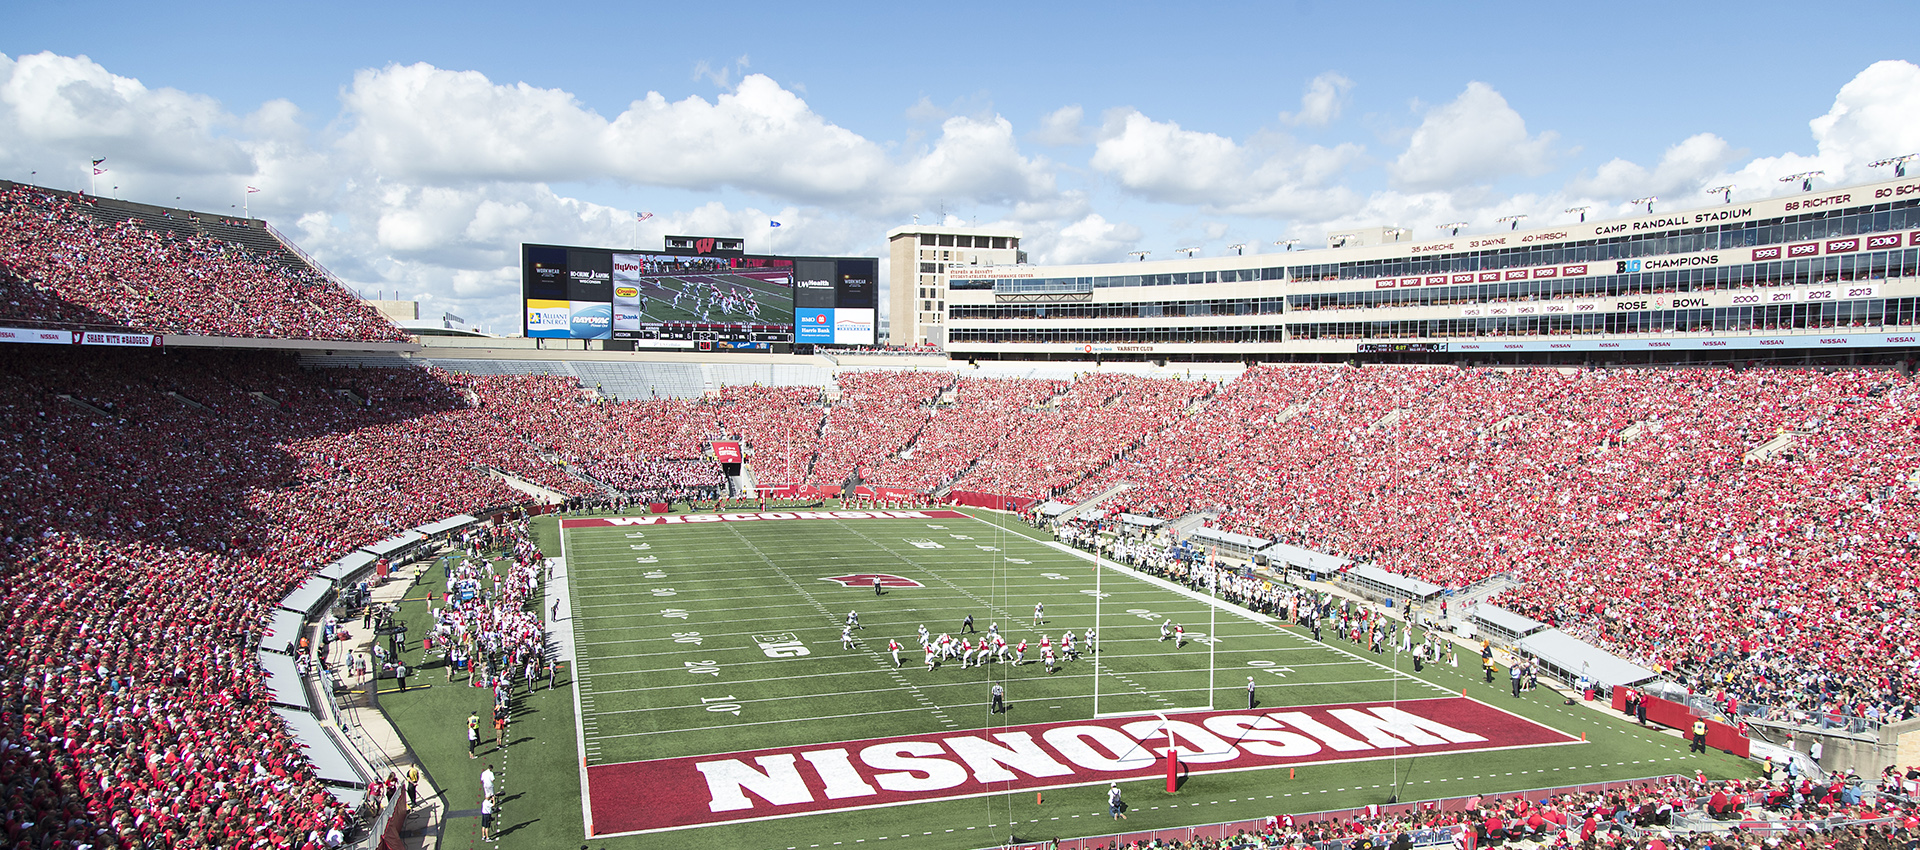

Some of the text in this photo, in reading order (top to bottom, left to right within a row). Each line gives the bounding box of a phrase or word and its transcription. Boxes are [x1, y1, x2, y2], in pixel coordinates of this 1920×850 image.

[1875, 188, 1892, 198] 80
[1785, 194, 1850, 211] 88 RICHTER
[1595, 208, 1752, 235] CAMP RANDALL STADIUM
[1535, 232, 1567, 241] HIRSCH
[1870, 236, 1898, 247] 2010
[696, 238, 714, 254] W
[1481, 238, 1506, 246] DAYNE
[1830, 241, 1856, 251] 1999
[1422, 243, 1454, 252] AMECHE
[1790, 244, 1816, 254] 1998
[1755, 249, 1778, 258] 1993
[1645, 256, 1719, 270] CHAMPIONS
[1772, 293, 1791, 301] 2011
[1808, 290, 1832, 299] 2012
[1848, 288, 1872, 296] 2013
[1617, 298, 1709, 310] ROSE BOWL
[1733, 295, 1759, 304] 2000
[87, 335, 104, 343] SHARE
[122, 336, 149, 345] #BADGERS
[604, 510, 932, 526] WISCONSIN
[671, 632, 703, 643] 30
[684, 660, 720, 674] 20
[1246, 660, 1296, 674] 10
[701, 694, 741, 712] 10
[694, 706, 1489, 813] WISCONSIN
